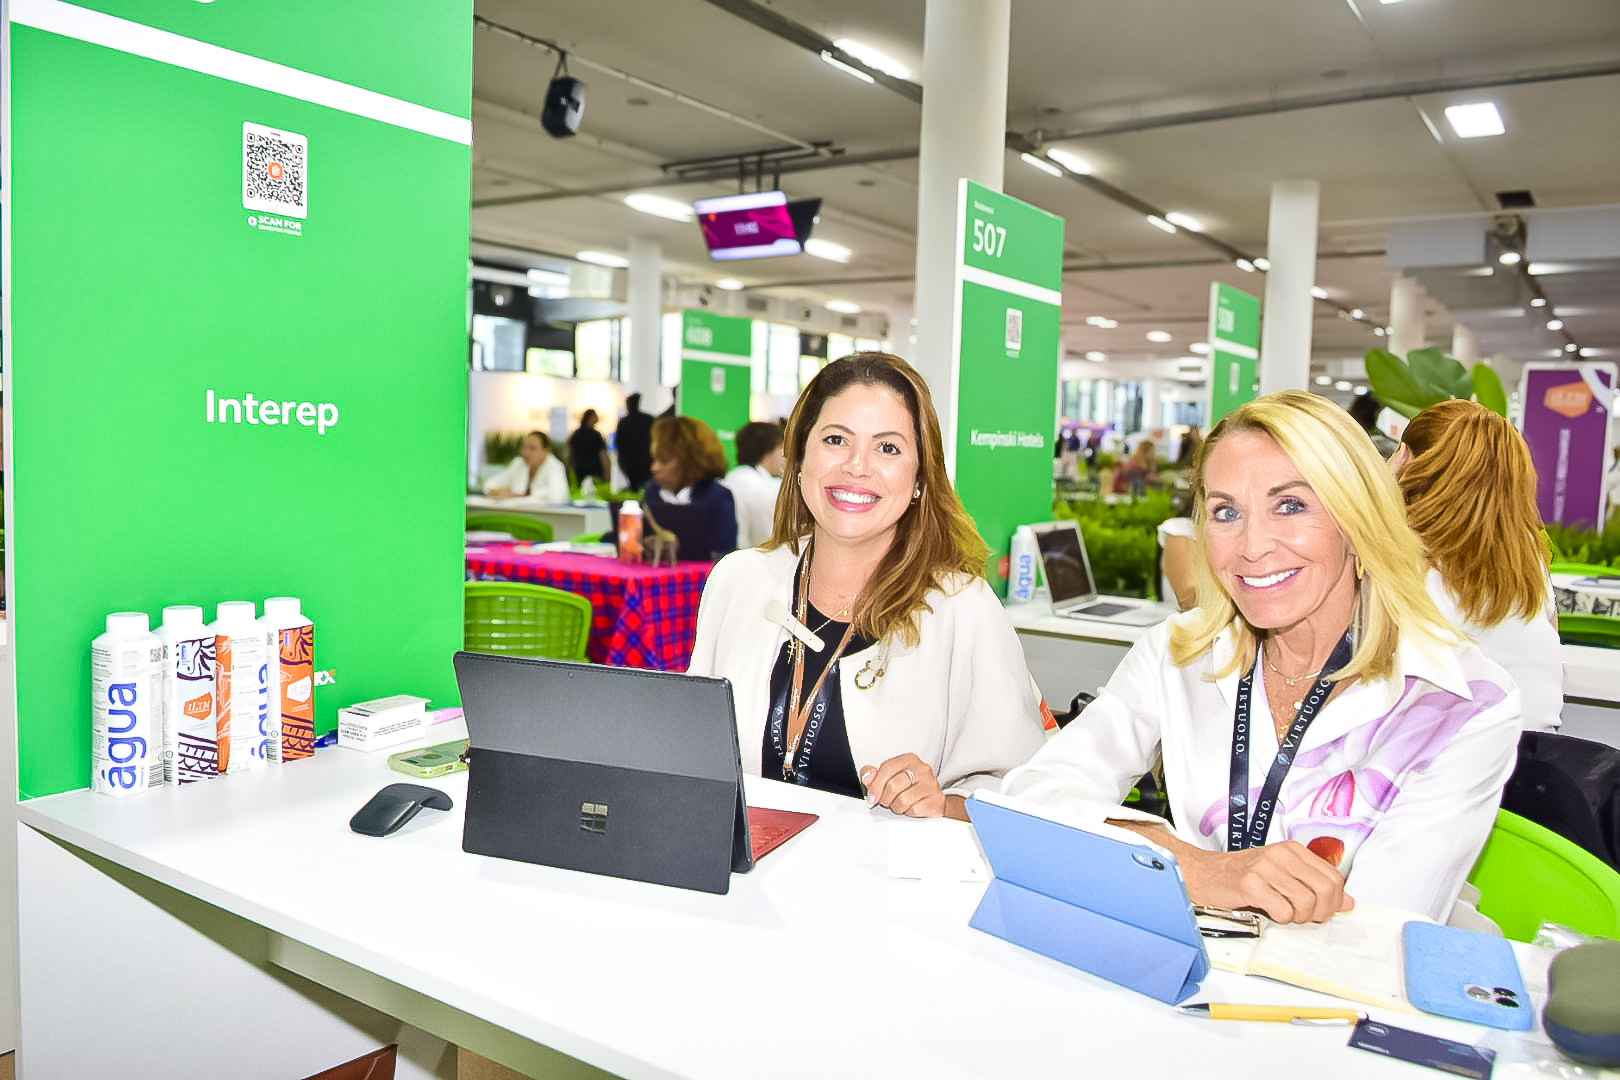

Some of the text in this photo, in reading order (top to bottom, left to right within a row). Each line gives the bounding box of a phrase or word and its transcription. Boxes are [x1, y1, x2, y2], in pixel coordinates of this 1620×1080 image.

[973, 218, 1007, 258] 507
[206, 389, 339, 435] Interep
[101, 682, 147, 790] água
